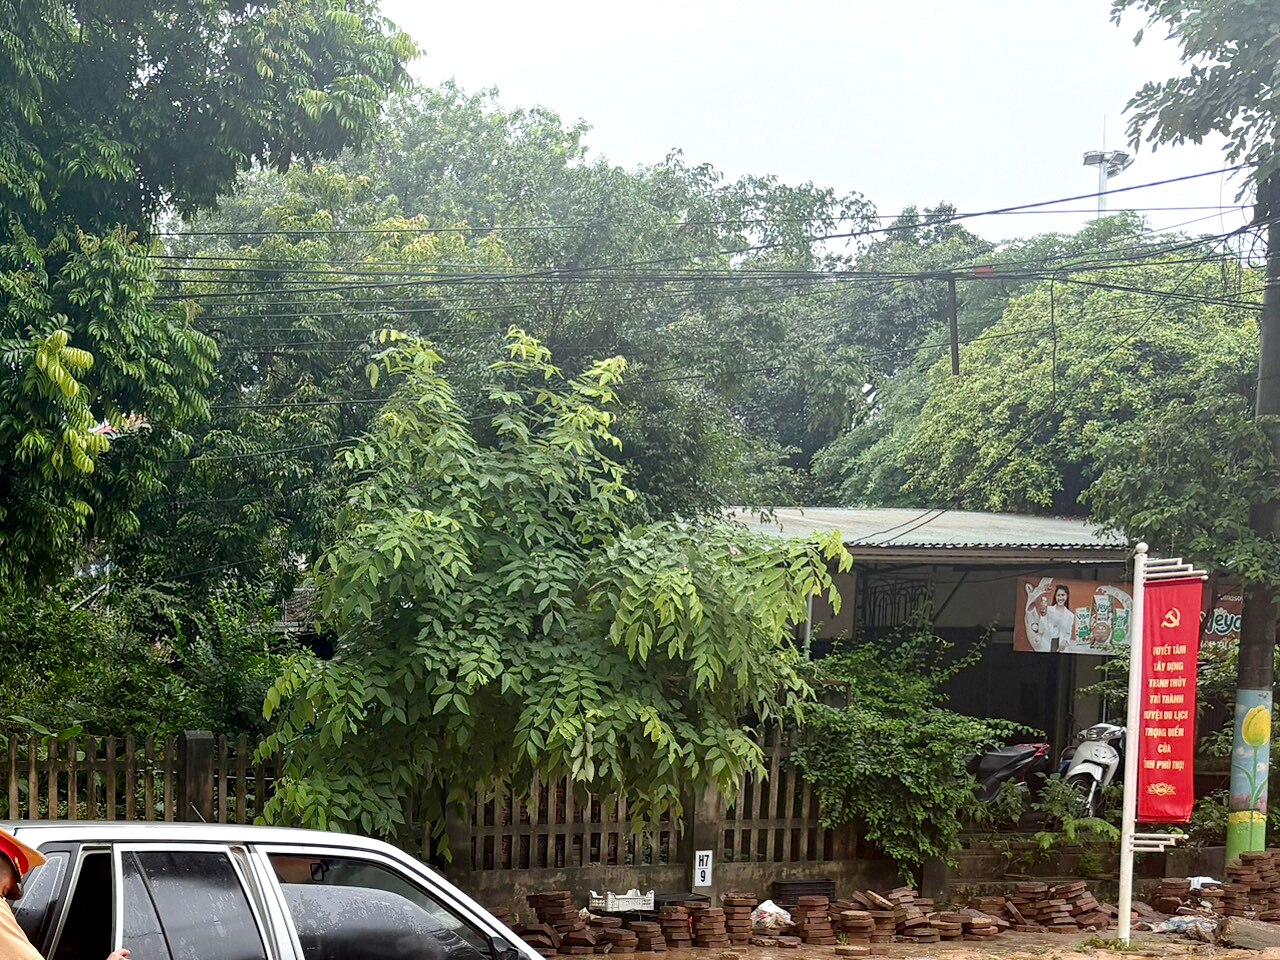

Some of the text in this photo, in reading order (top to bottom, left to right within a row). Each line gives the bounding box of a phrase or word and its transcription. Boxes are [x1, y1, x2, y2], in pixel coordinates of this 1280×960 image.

[1143, 757, 1155, 769] ỈNH
[698, 854, 709, 867] H7
[700, 869, 706, 882] 9
